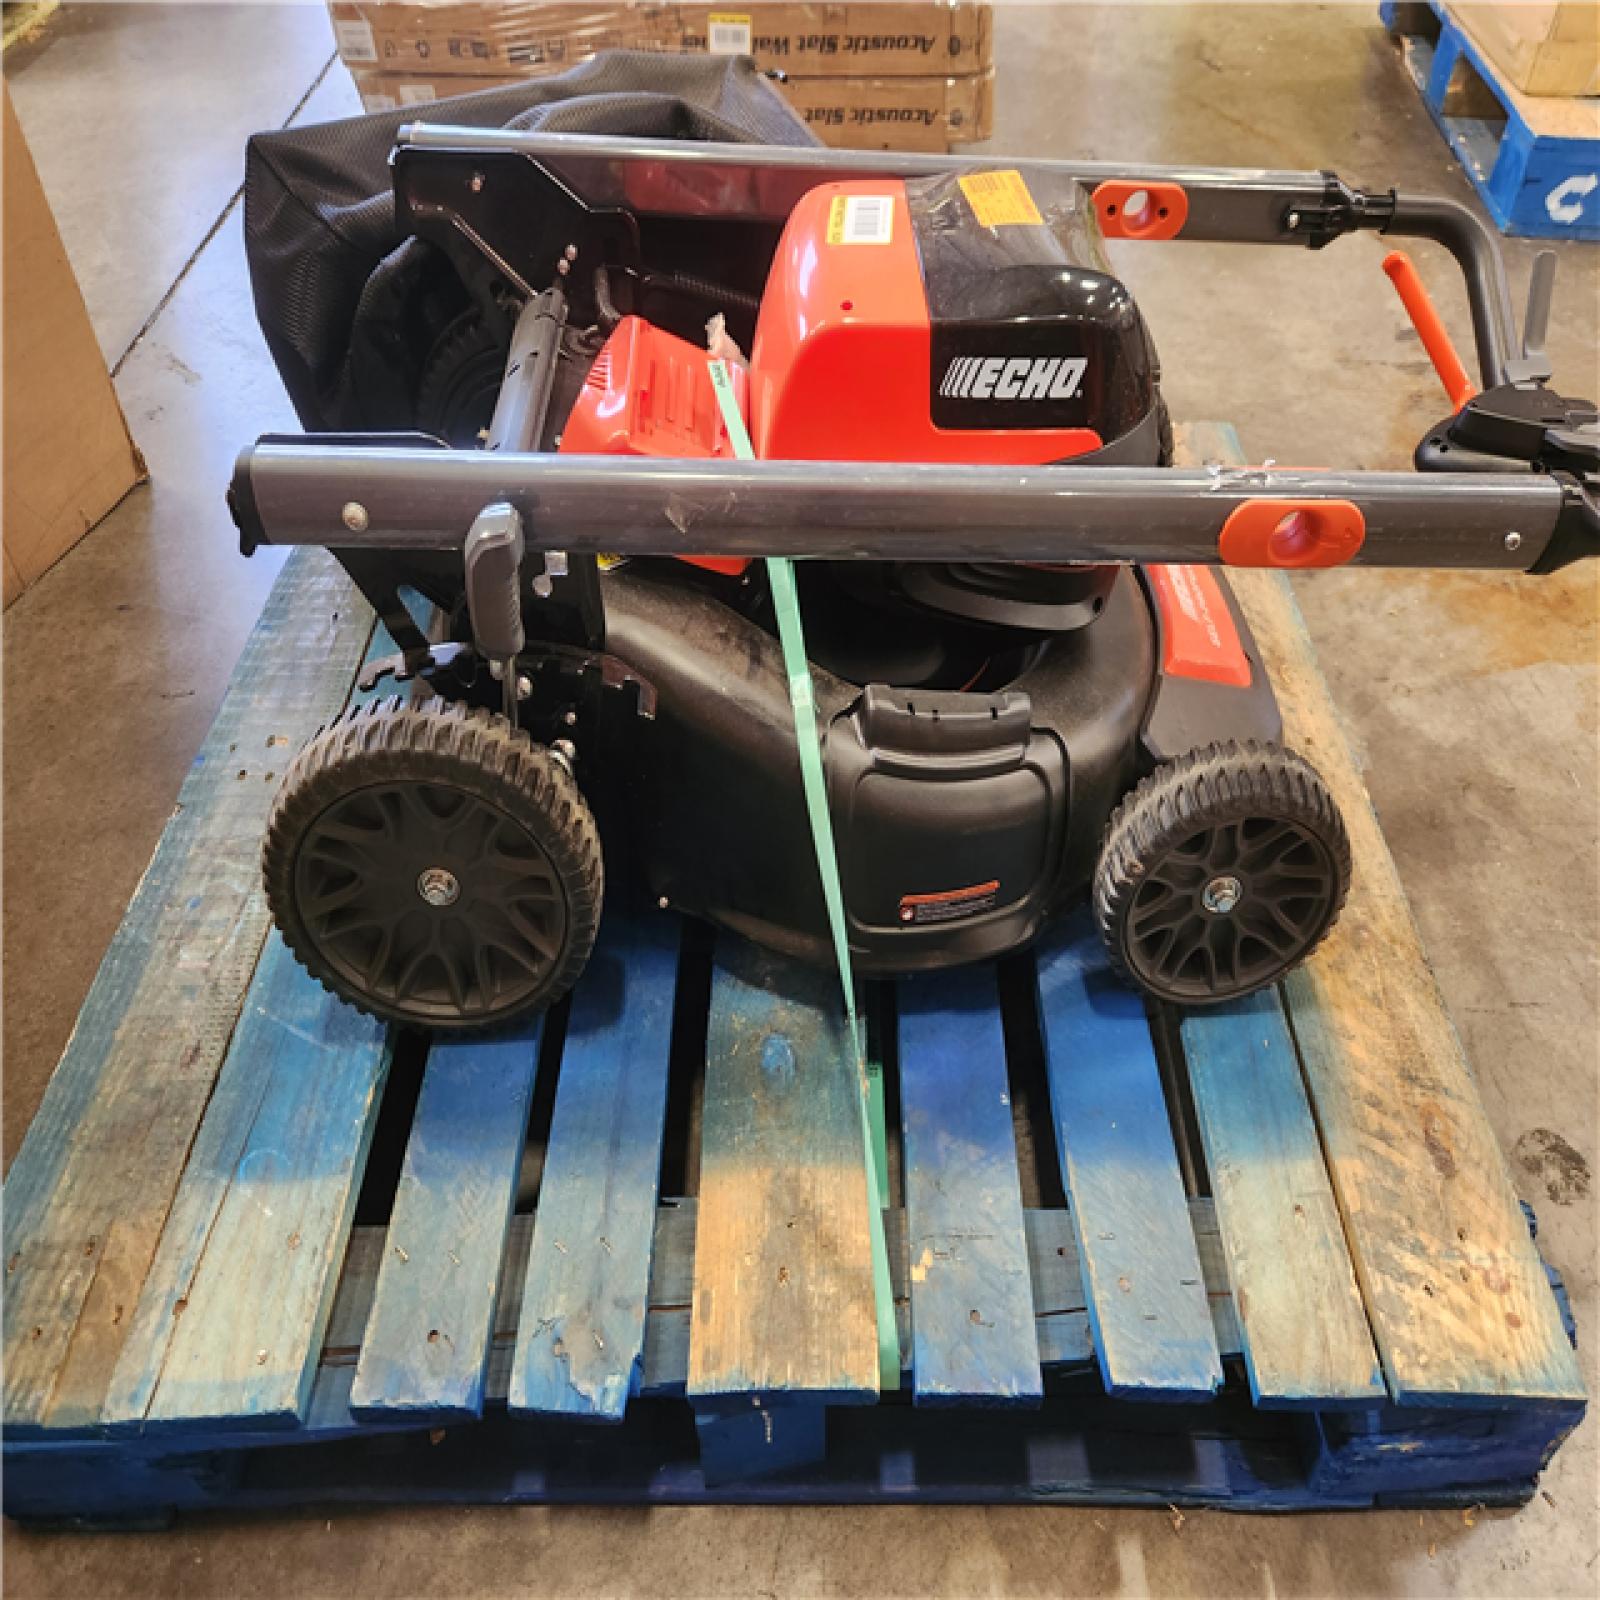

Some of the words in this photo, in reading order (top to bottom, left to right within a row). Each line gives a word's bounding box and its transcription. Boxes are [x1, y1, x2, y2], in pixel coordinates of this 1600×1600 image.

[797, 34, 839, 55] Slat
[844, 34, 936, 55] Acoustic
[805, 107, 845, 126] Slat
[849, 107, 938, 126] Acoustic
[971, 356, 1089, 399] ECHO
